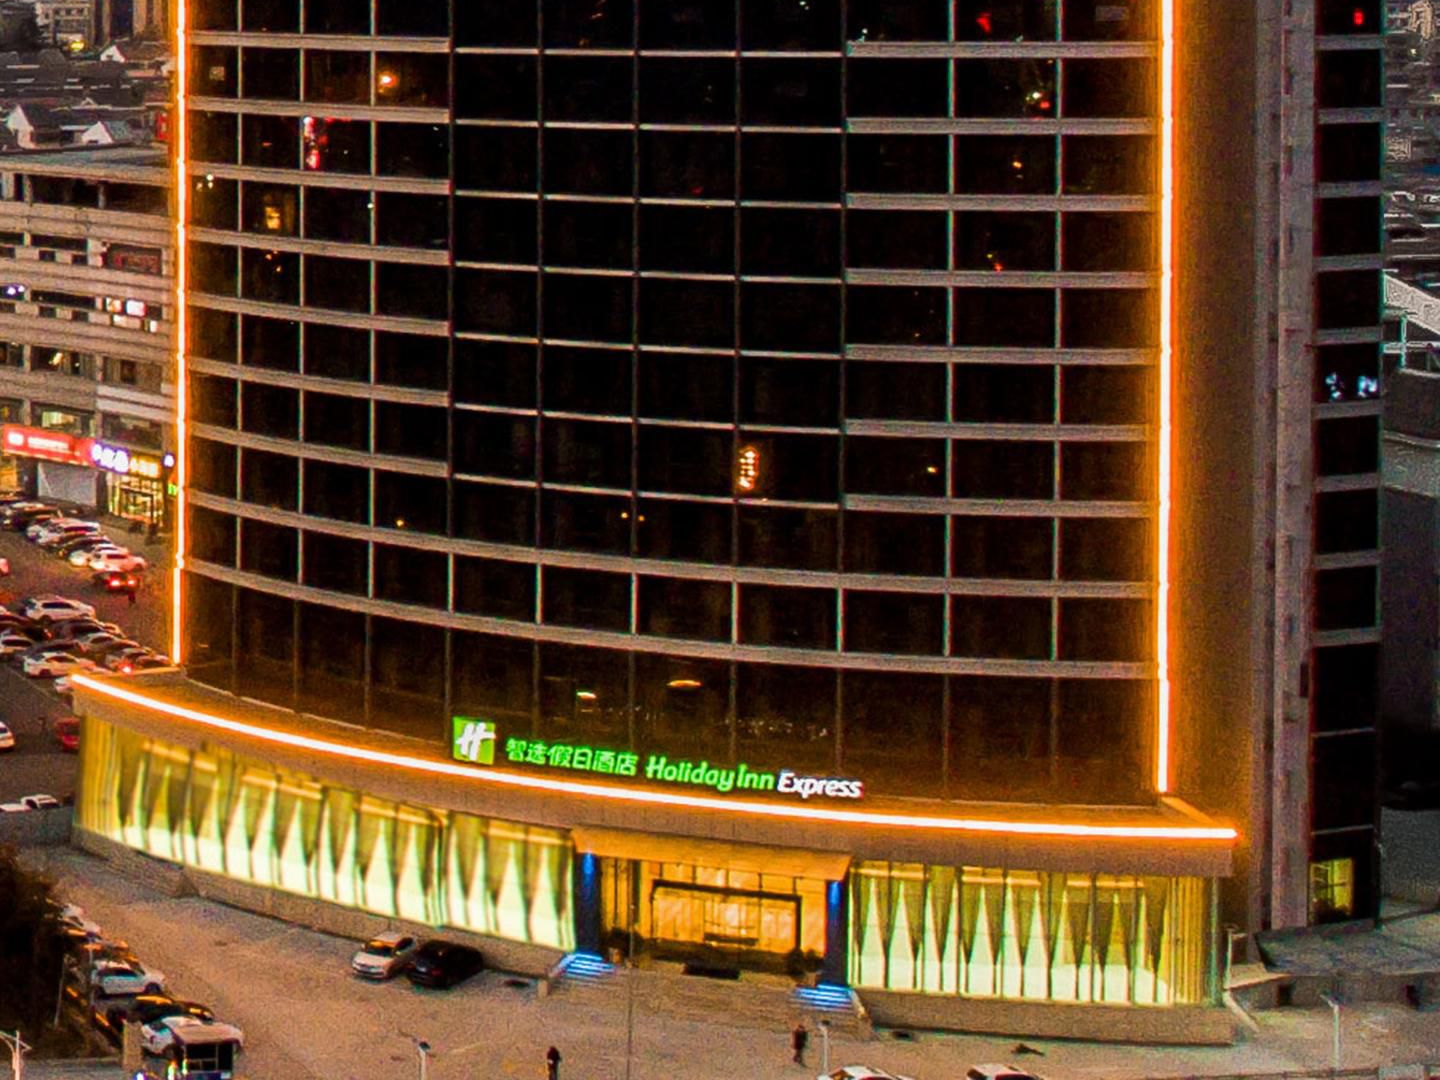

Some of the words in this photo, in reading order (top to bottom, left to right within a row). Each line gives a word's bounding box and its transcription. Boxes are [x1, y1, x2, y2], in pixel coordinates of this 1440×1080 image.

[506, 737, 639, 777] 智选假日酒店
[645, 755, 735, 792] Holiday
[736, 763, 775, 791] Inn
[776, 771, 864, 799] Express
